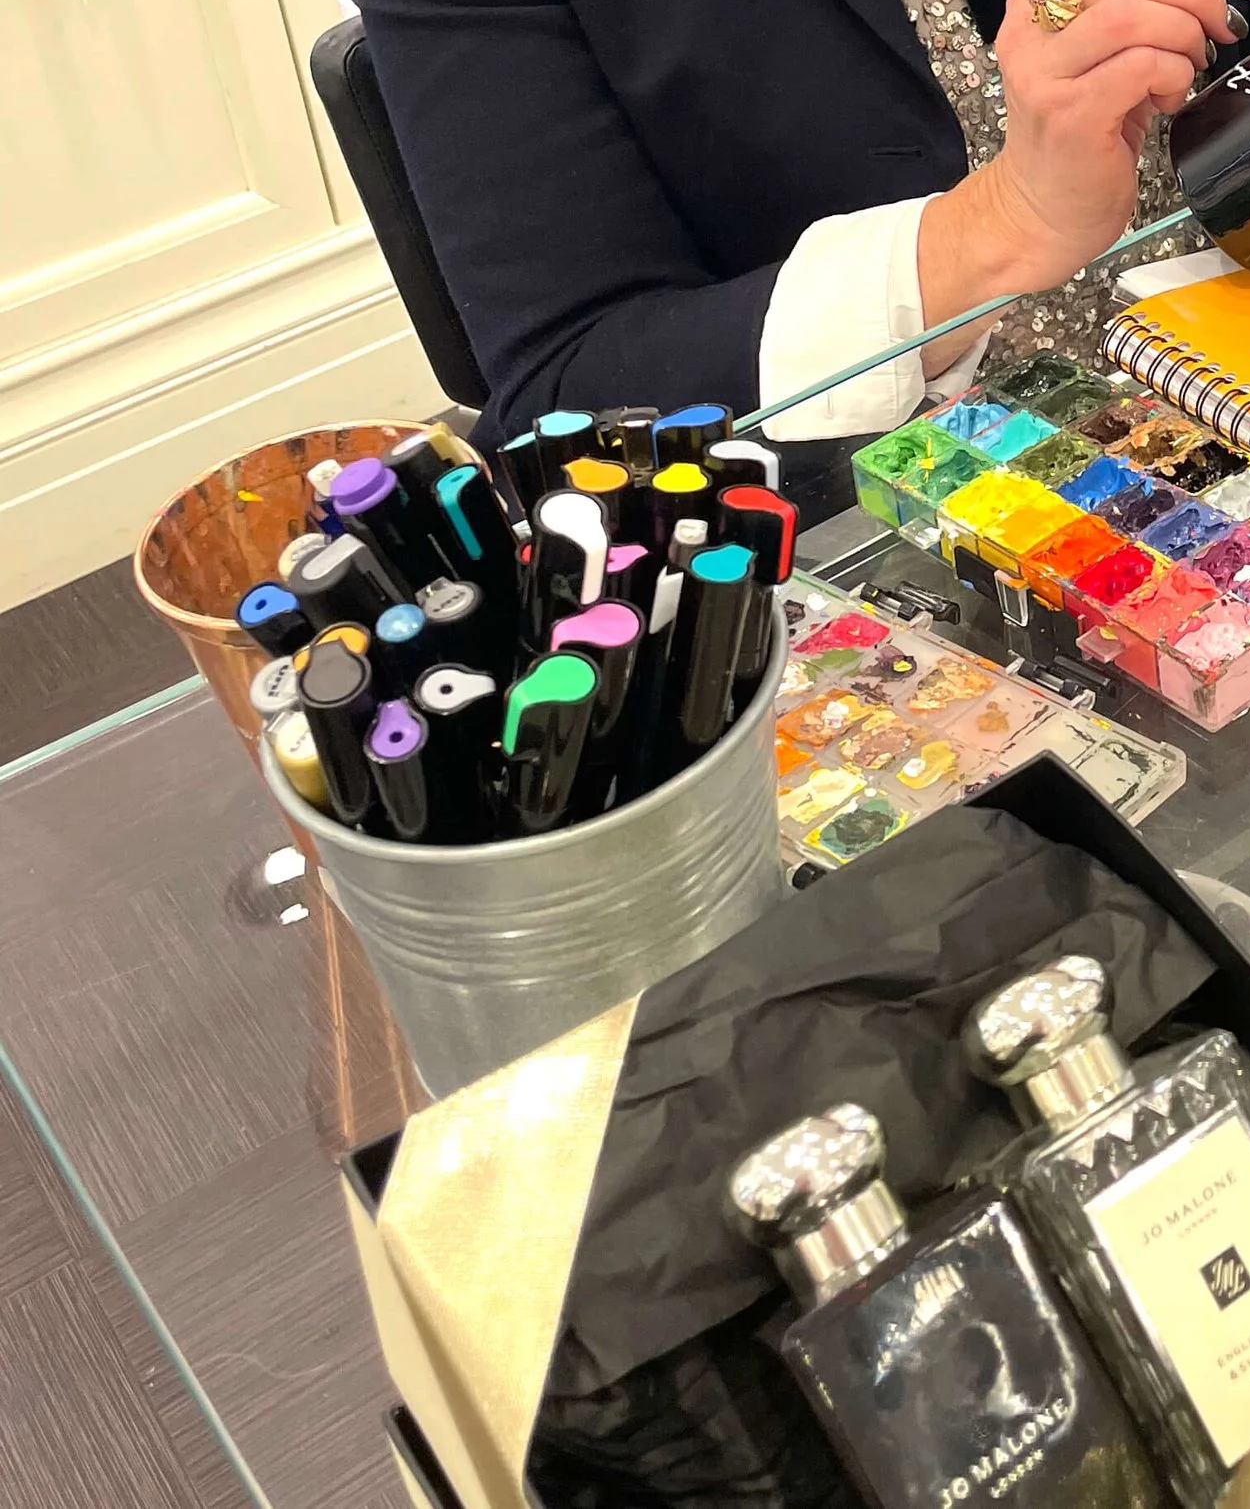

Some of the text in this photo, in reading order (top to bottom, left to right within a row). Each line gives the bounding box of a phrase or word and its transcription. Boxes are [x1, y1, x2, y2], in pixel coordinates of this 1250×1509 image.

[1142, 1169, 1237, 1247] JO MALONE
[940, 1397, 1069, 1509] JO MALONE
